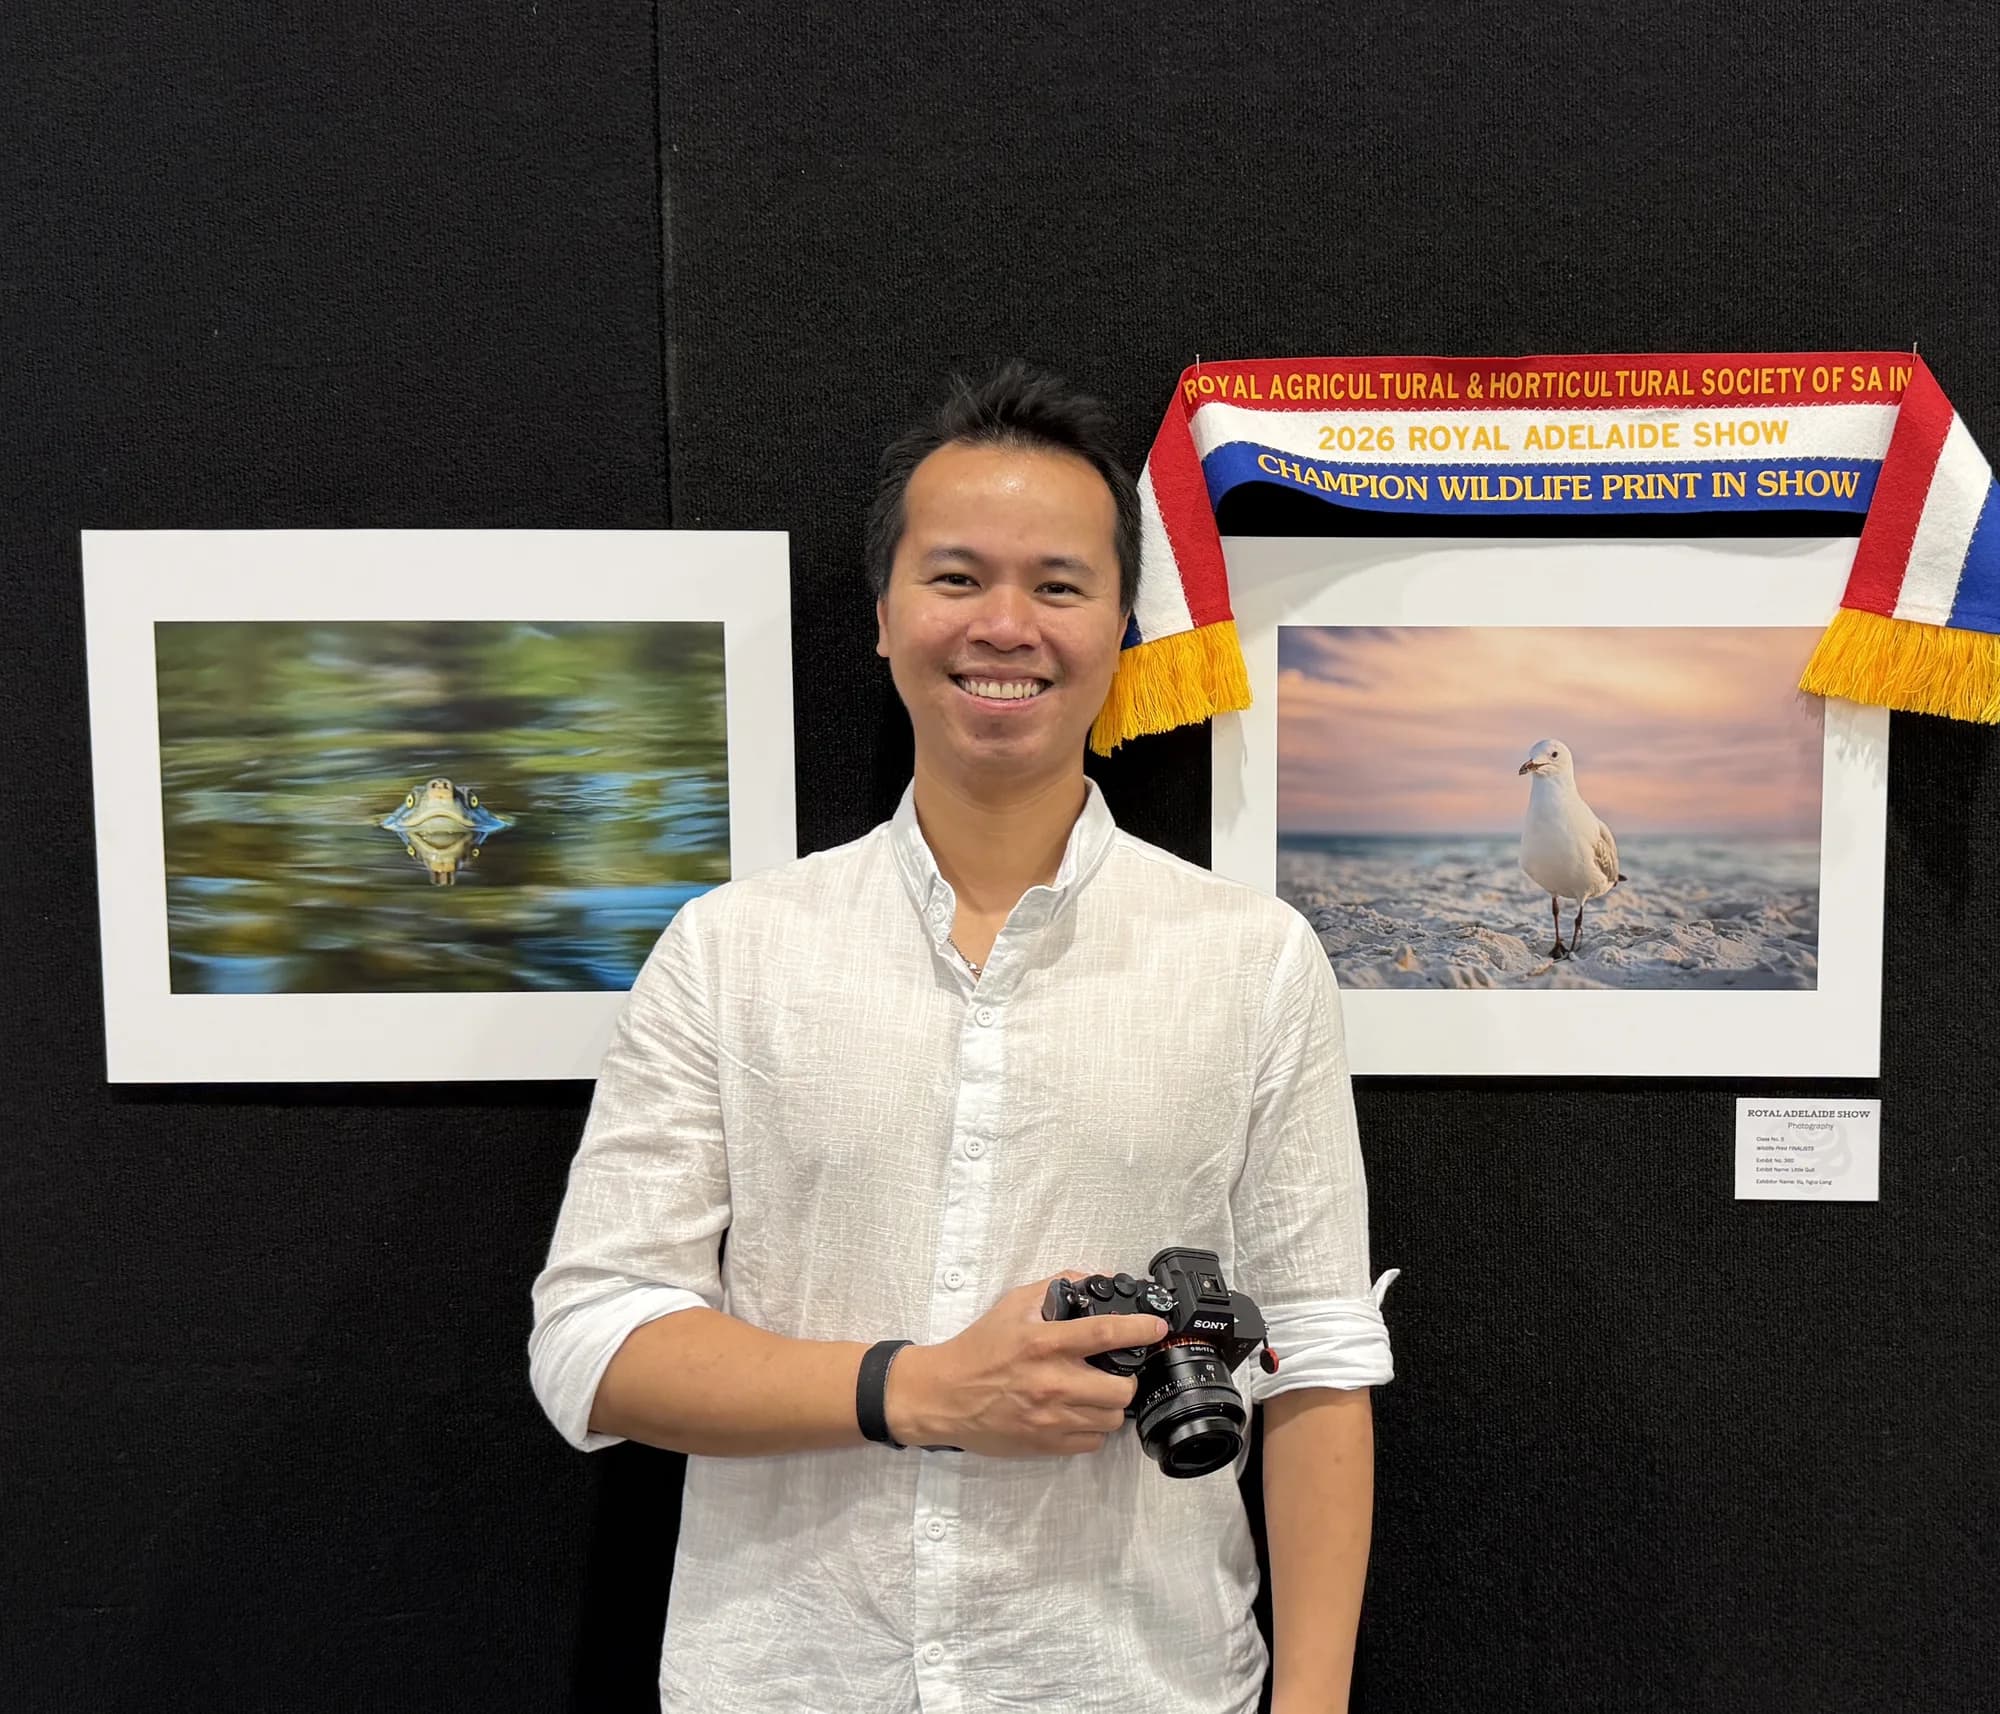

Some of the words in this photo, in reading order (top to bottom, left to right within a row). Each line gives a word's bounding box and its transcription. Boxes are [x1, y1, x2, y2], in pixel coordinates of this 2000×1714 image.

[1184, 373, 1262, 404] ROYAL
[1269, 372, 1459, 400] AGRICULTURAL
[1467, 373, 1484, 399] &
[1490, 370, 1694, 399] HORTICULTURAL
[1701, 367, 1805, 396] SOCIETY
[1811, 366, 1845, 393] OF
[1850, 365, 1883, 393] SA
[1318, 426, 1395, 452] 2026
[1408, 425, 1510, 452] ROYAL
[1523, 422, 1680, 451] ADELAIDE
[1693, 420, 1789, 449] SHOW
[1257, 453, 1429, 501] CHAMPION
[1438, 475, 1593, 502] WILDLIFE
[1602, 472, 1702, 501] PRINT
[1711, 471, 1748, 498] IN
[1756, 469, 1861, 499] SHOW
[1747, 1109, 1782, 1118] ROYAL
[1783, 1109, 1835, 1118] ADELAIDE
[1837, 1110, 1871, 1119] SHOW
[1787, 1121, 1834, 1131] Photography
[1193, 1319, 1229, 1330] SONY
